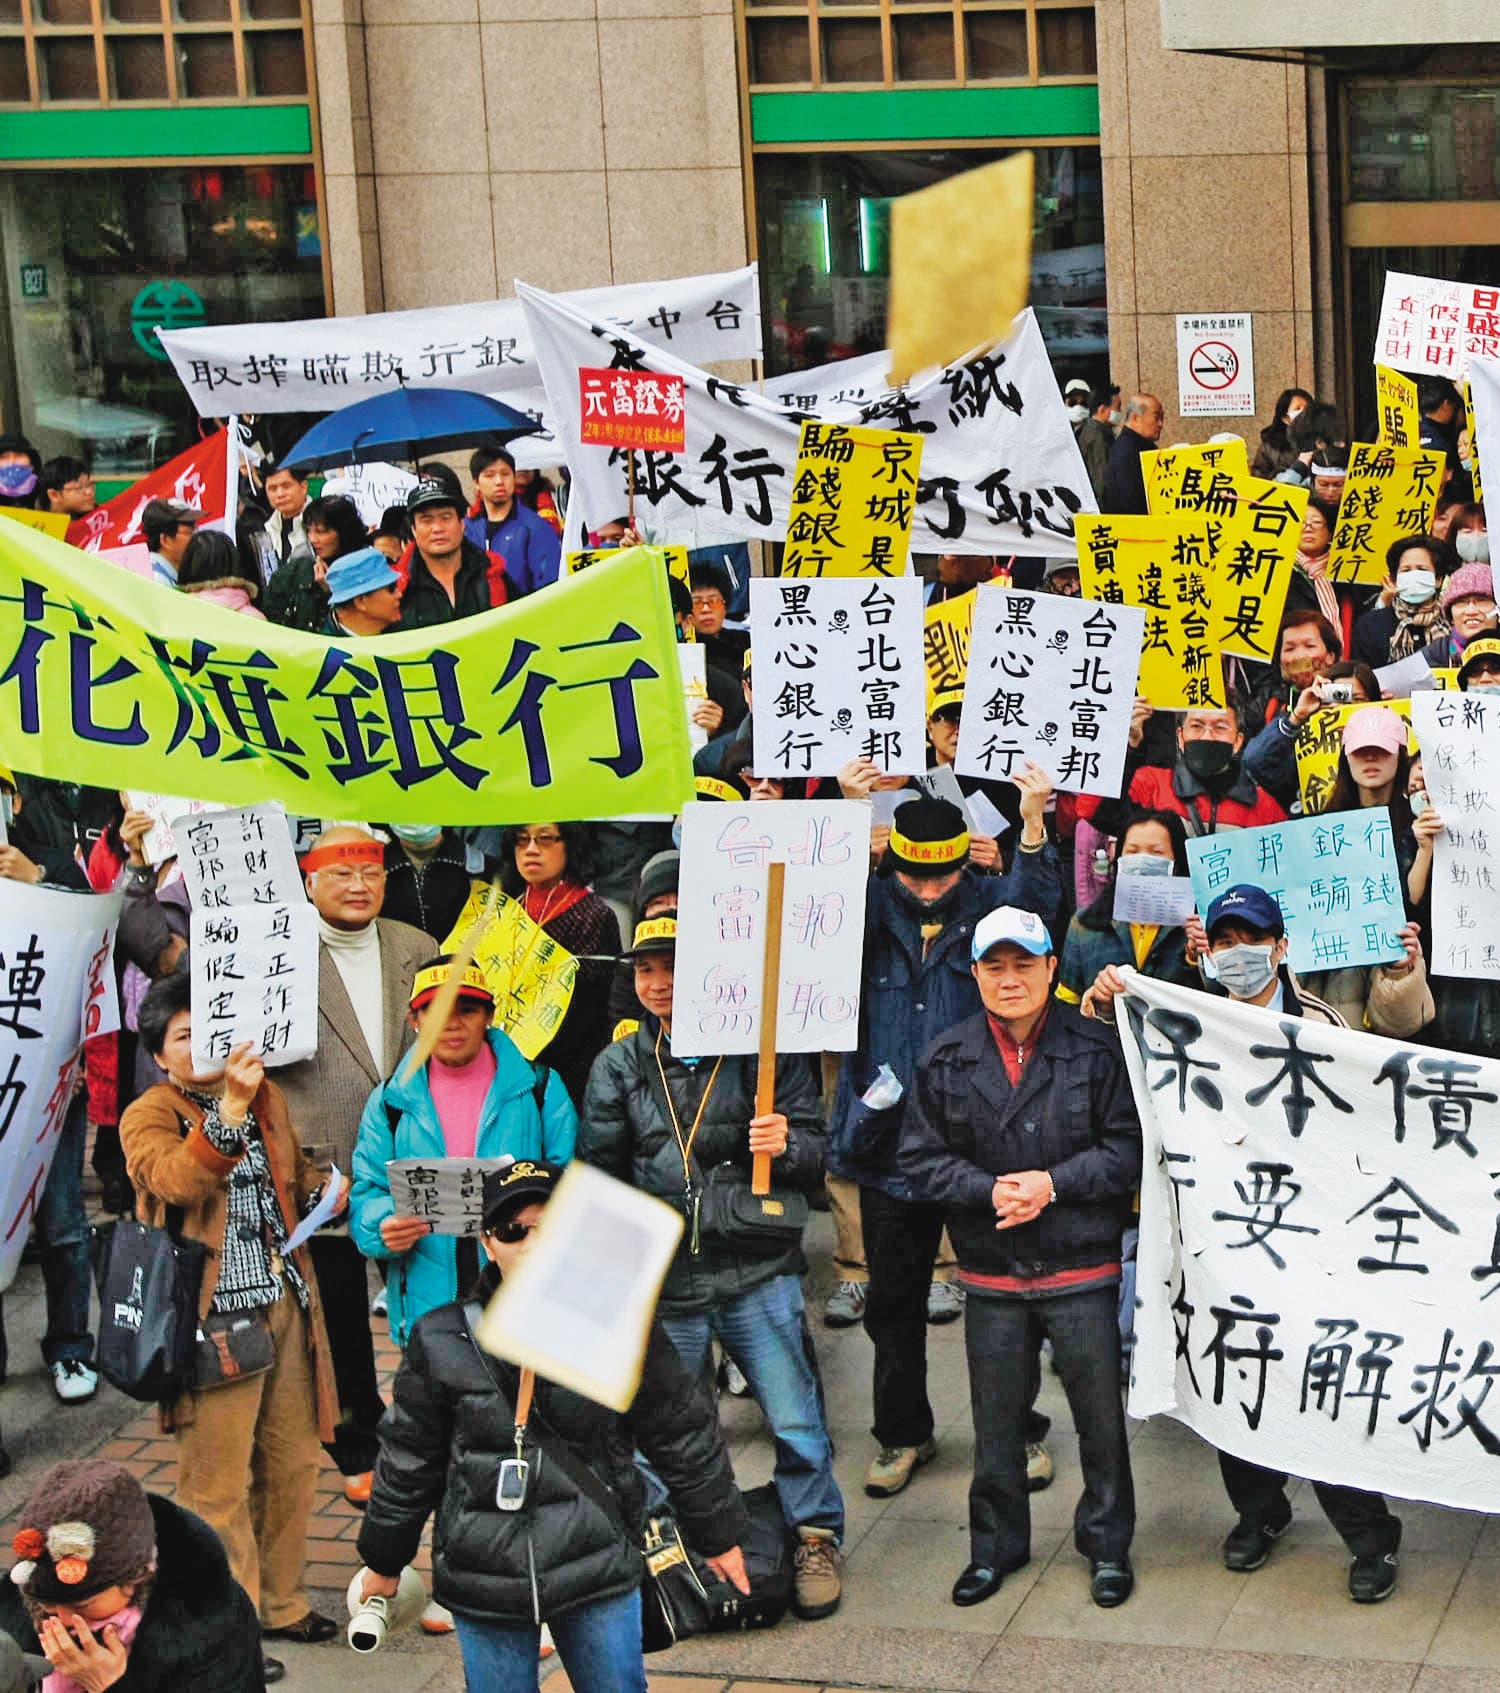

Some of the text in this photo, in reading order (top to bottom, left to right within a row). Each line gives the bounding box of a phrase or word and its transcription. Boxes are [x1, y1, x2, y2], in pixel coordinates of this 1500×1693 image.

[585, 376, 684, 424] 元富證券
[784, 423, 856, 578] 騙錢銀行
[858, 436, 919, 578] 京城是
[1219, 486, 1300, 657] 台新是
[1330, 446, 1396, 584] 騙錢銀行
[1396, 453, 1439, 537] 京城
[1, 577, 661, 792] 花旗銀行
[773, 584, 824, 772] 黑心銀行
[857, 583, 902, 772] 台北富邦
[976, 596, 1038, 777] 黑心銀行
[1057, 607, 1118, 790] 台北富邦
[1171, 534, 1224, 710] 抗議台新銀
[1200, 819, 1393, 890] 富邦銀行
